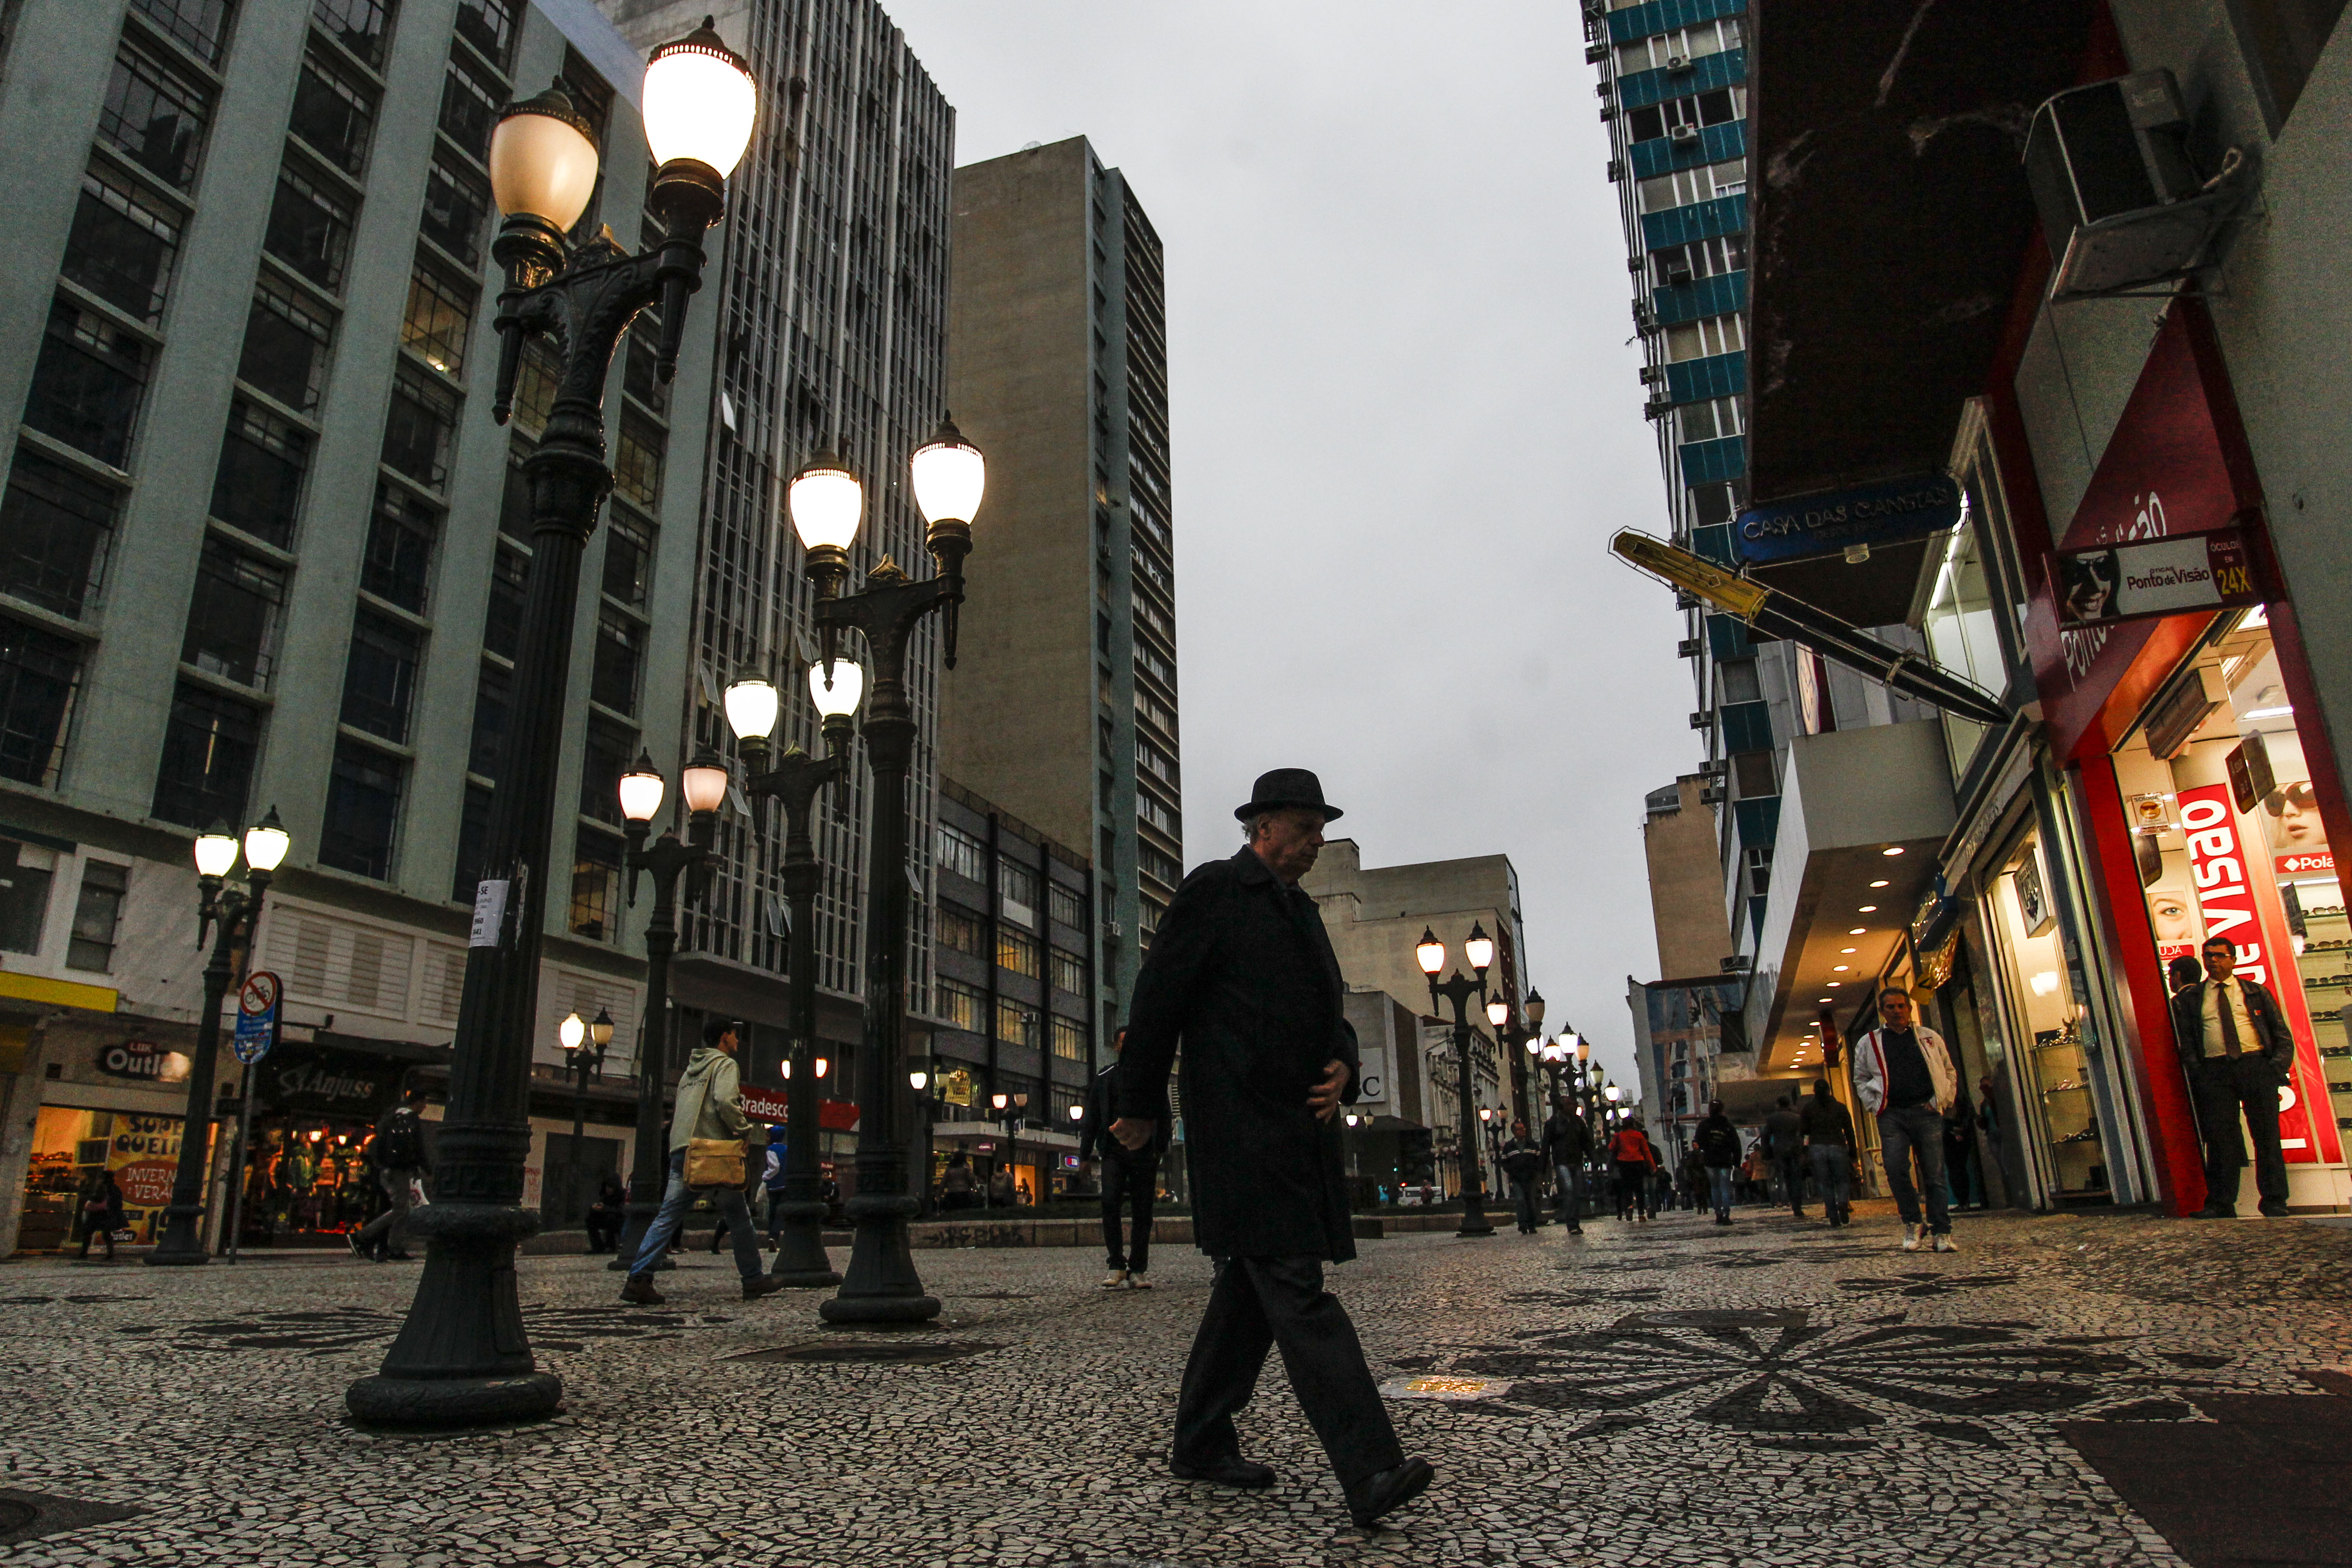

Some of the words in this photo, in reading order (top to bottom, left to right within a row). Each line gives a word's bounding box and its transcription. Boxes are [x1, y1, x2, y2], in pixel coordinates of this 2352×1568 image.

[1744, 515, 1801, 539] CASA
[1805, 506, 1847, 528] DAS
[2127, 574, 2164, 590] Ponto
[2165, 576, 2176, 585] de
[2173, 568, 2210, 583] Visão
[2217, 566, 2252, 595] 24X
[2300, 856, 2334, 870] Pola
[126, 1167, 177, 1183] INVERN
[135, 1184, 173, 1200] VERA
